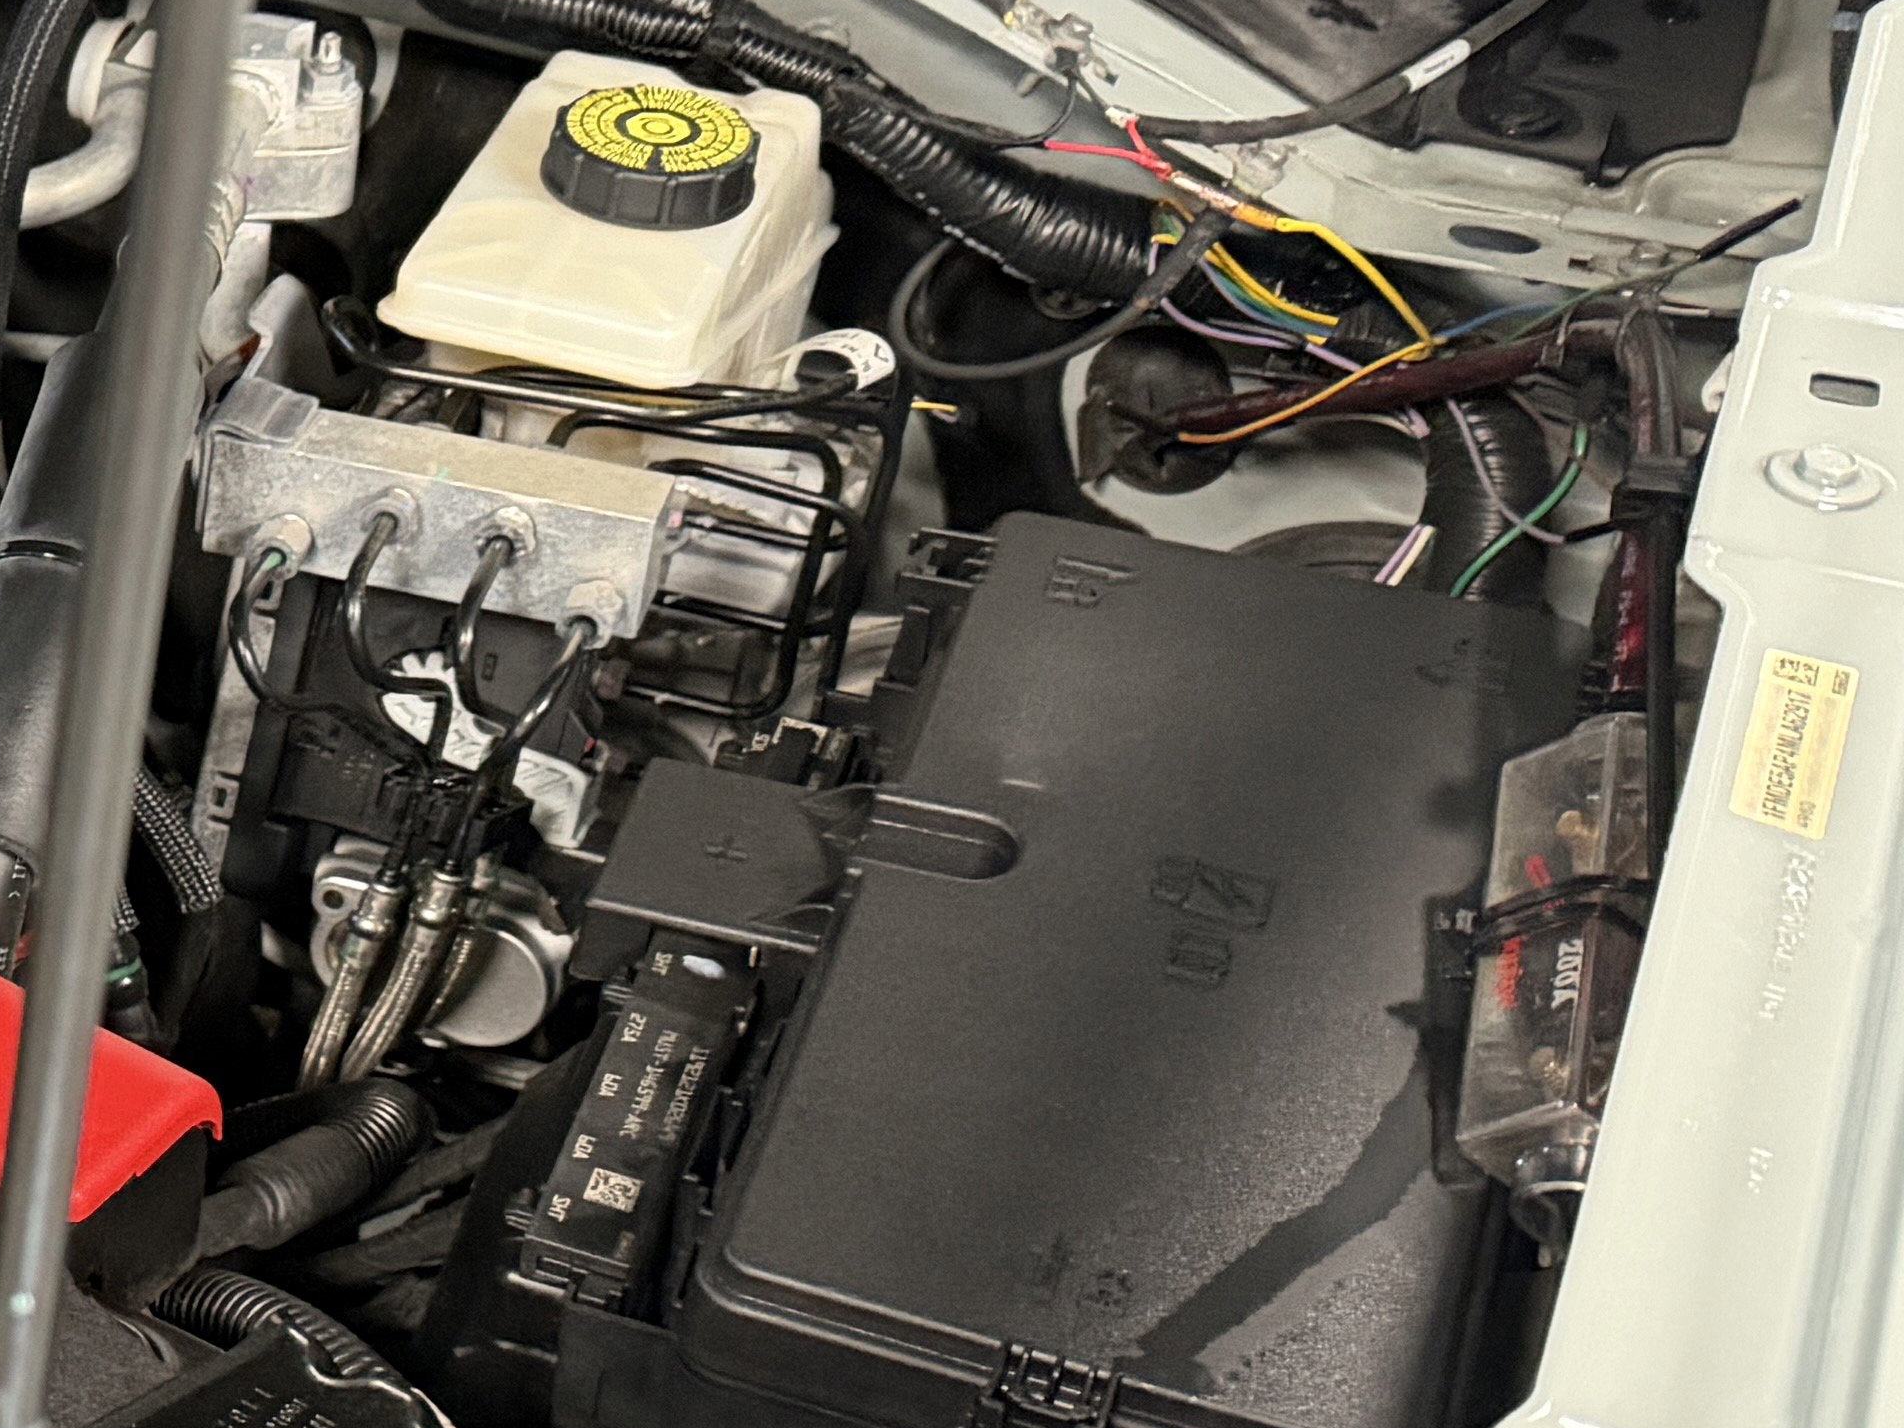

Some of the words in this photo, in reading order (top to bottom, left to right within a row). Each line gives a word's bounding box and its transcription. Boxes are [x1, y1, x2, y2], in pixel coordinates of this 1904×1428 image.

[1550, 937, 1584, 1010] 200A
[619, 1010, 647, 1045] 275A
[597, 1071, 622, 1099] 60A
[570, 1132, 598, 1162] 60A
